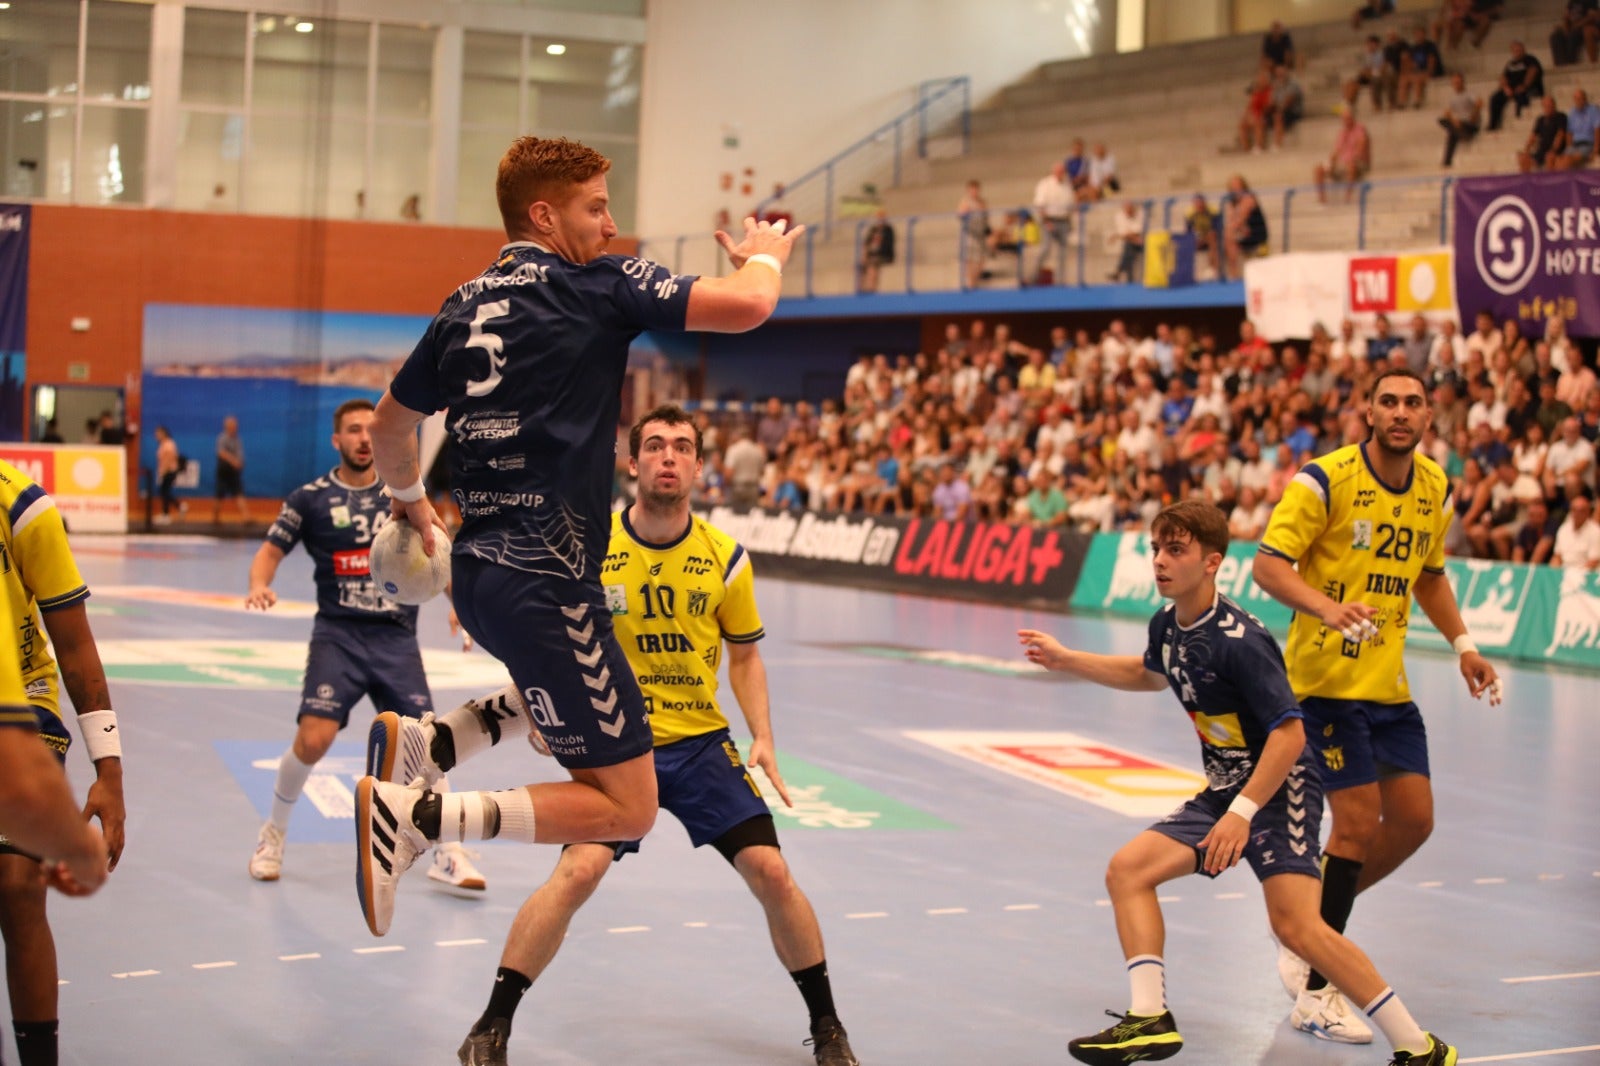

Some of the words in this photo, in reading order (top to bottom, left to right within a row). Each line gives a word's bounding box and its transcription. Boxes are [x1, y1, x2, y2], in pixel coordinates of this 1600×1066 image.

[1353, 269, 1390, 304] TM
[465, 298, 511, 397] 5
[351, 510, 387, 544] 34
[1375, 523, 1414, 562] 28
[340, 556, 369, 571] TM
[862, 526, 900, 566] en
[895, 518, 1064, 585] LALIGA+
[639, 583, 676, 620] 10
[1366, 573, 1410, 597] IRUN
[636, 632, 697, 654] IRUN
[638, 675, 705, 687] GIPUZKOA
[662, 701, 714, 712] MOYUA
